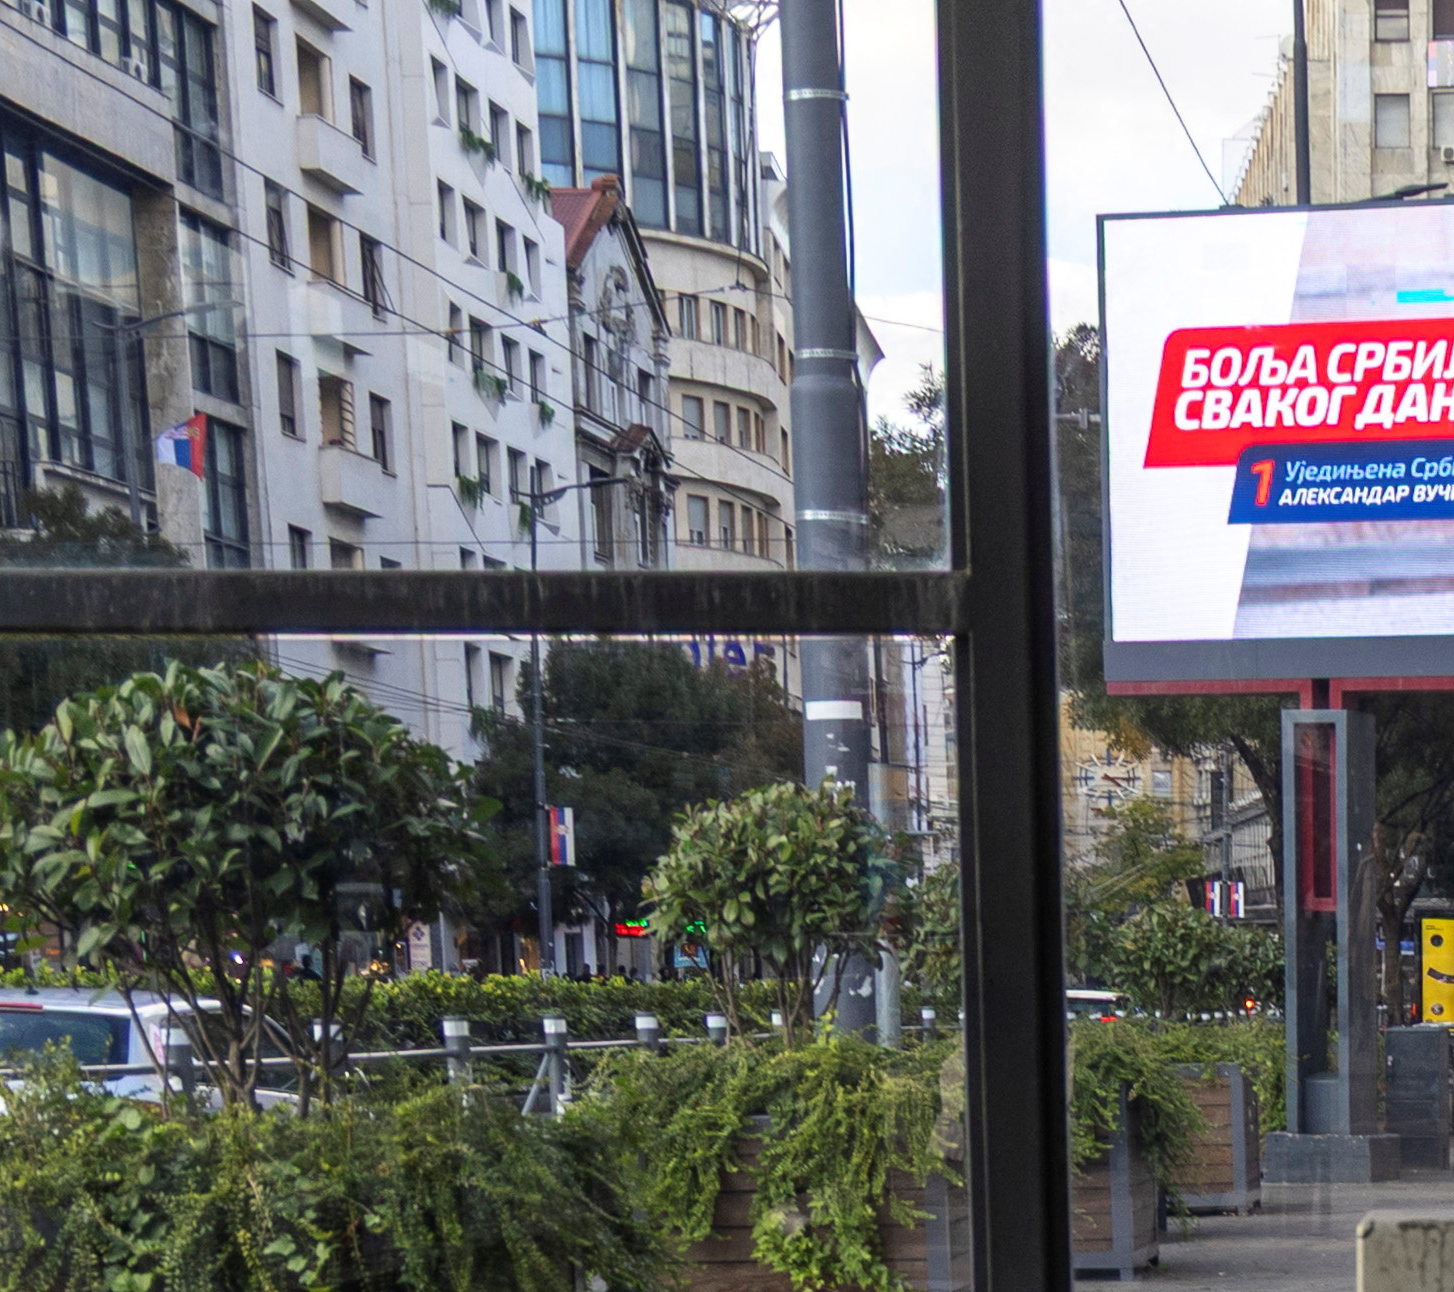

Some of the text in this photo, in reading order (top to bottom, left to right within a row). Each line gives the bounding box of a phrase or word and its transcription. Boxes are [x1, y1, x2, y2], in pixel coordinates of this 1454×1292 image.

[1181, 345, 1318, 389] БОЉА
[1173, 385, 1358, 431] СВАКОГ
[1250, 459, 1275, 507] 1
[1285, 459, 1406, 484] Уједињена
[1278, 484, 1410, 507] АЛЕКСАНДАР
